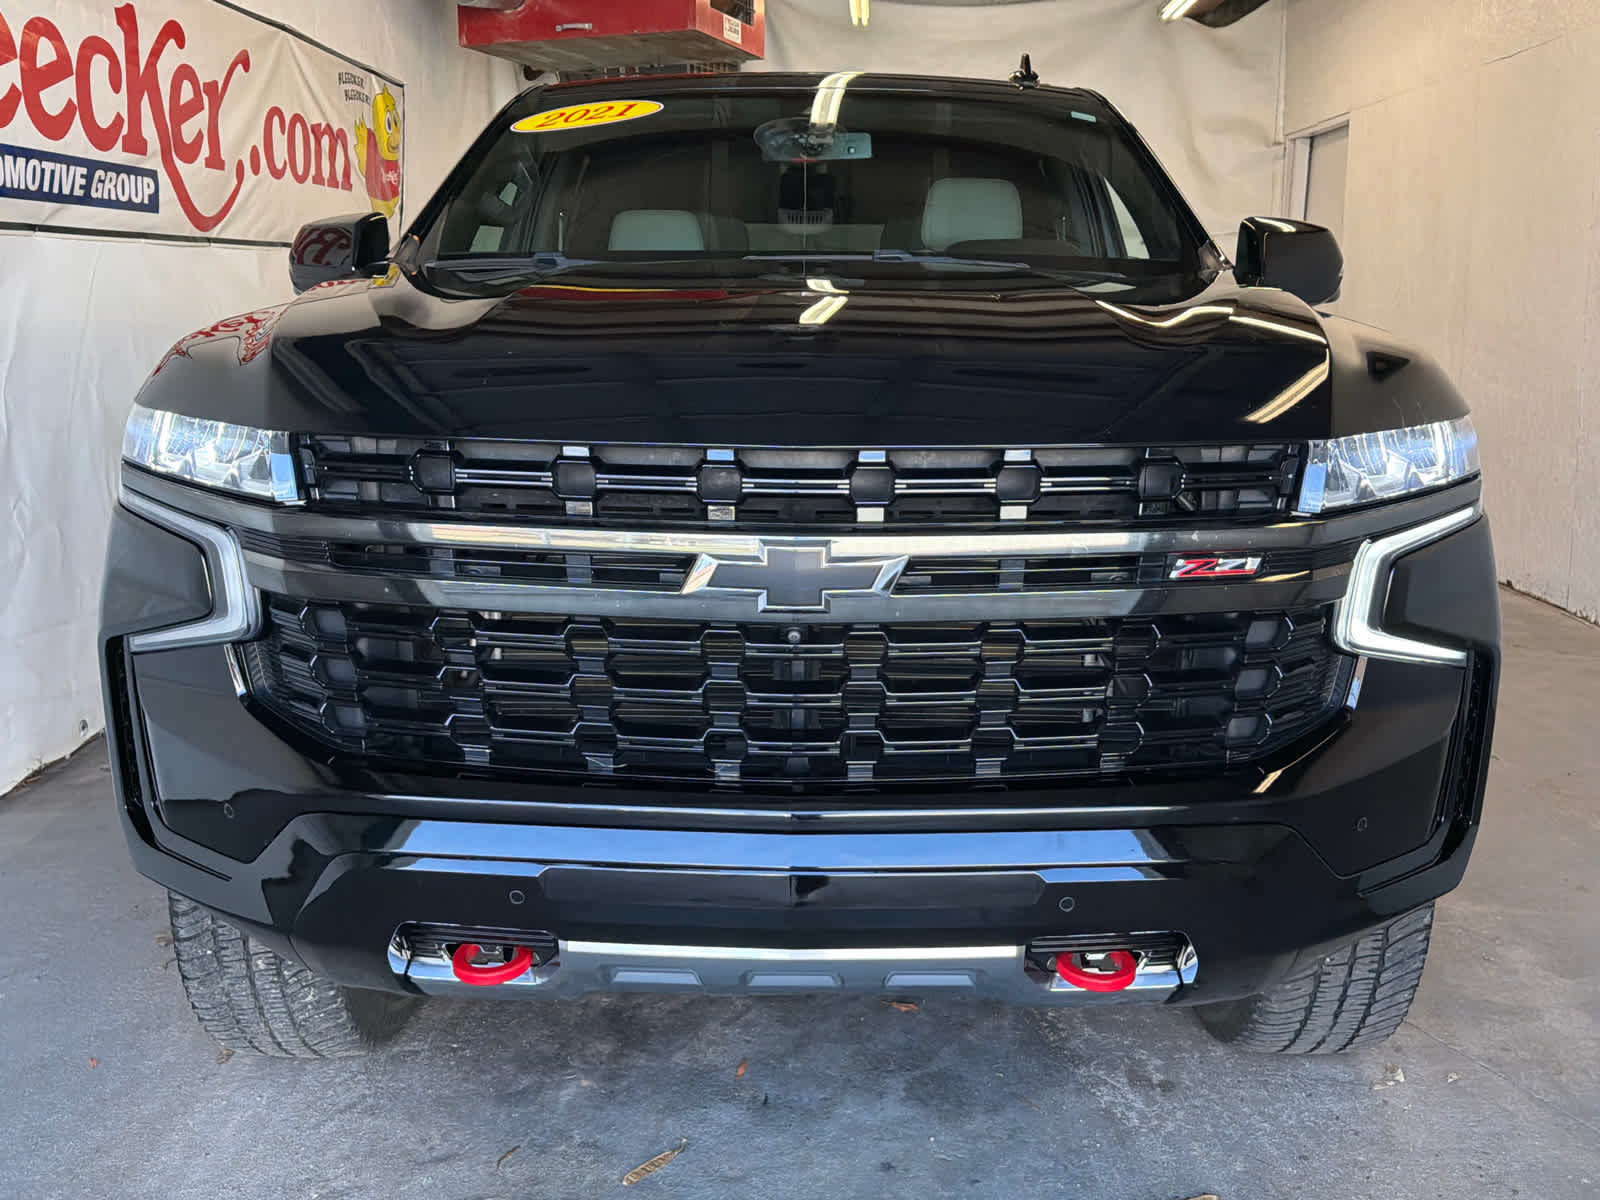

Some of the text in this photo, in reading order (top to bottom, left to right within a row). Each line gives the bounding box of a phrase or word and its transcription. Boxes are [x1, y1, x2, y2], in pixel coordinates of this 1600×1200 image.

[535, 103, 638, 129] 2021
[0, 154, 156, 205] MOTIVE GROUP
[1169, 556, 1262, 579] Z71
